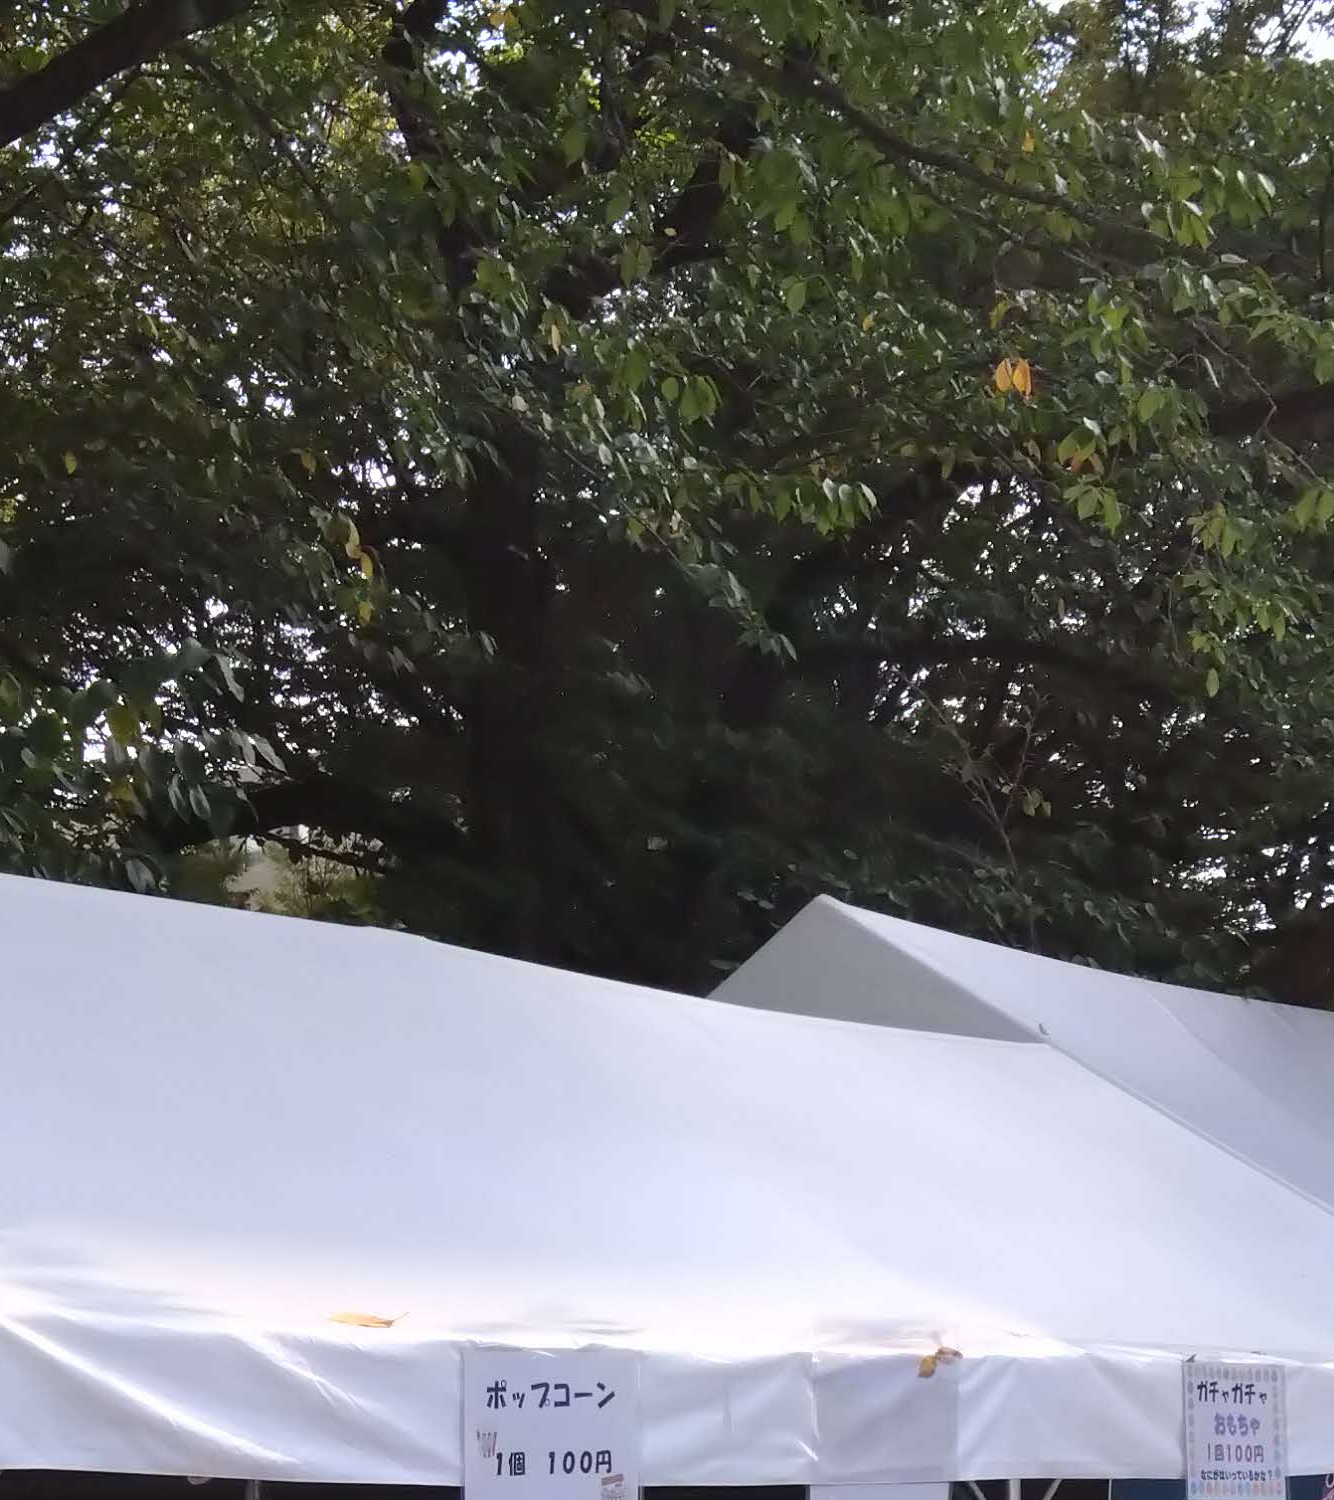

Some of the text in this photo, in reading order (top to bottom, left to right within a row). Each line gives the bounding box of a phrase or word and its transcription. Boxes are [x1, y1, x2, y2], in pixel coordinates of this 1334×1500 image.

[486, 1379, 616, 1410] ポップコーン
[1197, 1380, 1268, 1405] ガチャガチャ
[1214, 1412, 1260, 1437] おもちゃ
[496, 1449, 612, 1476] 1個 100円
[1207, 1442, 1265, 1463] 1回100円
